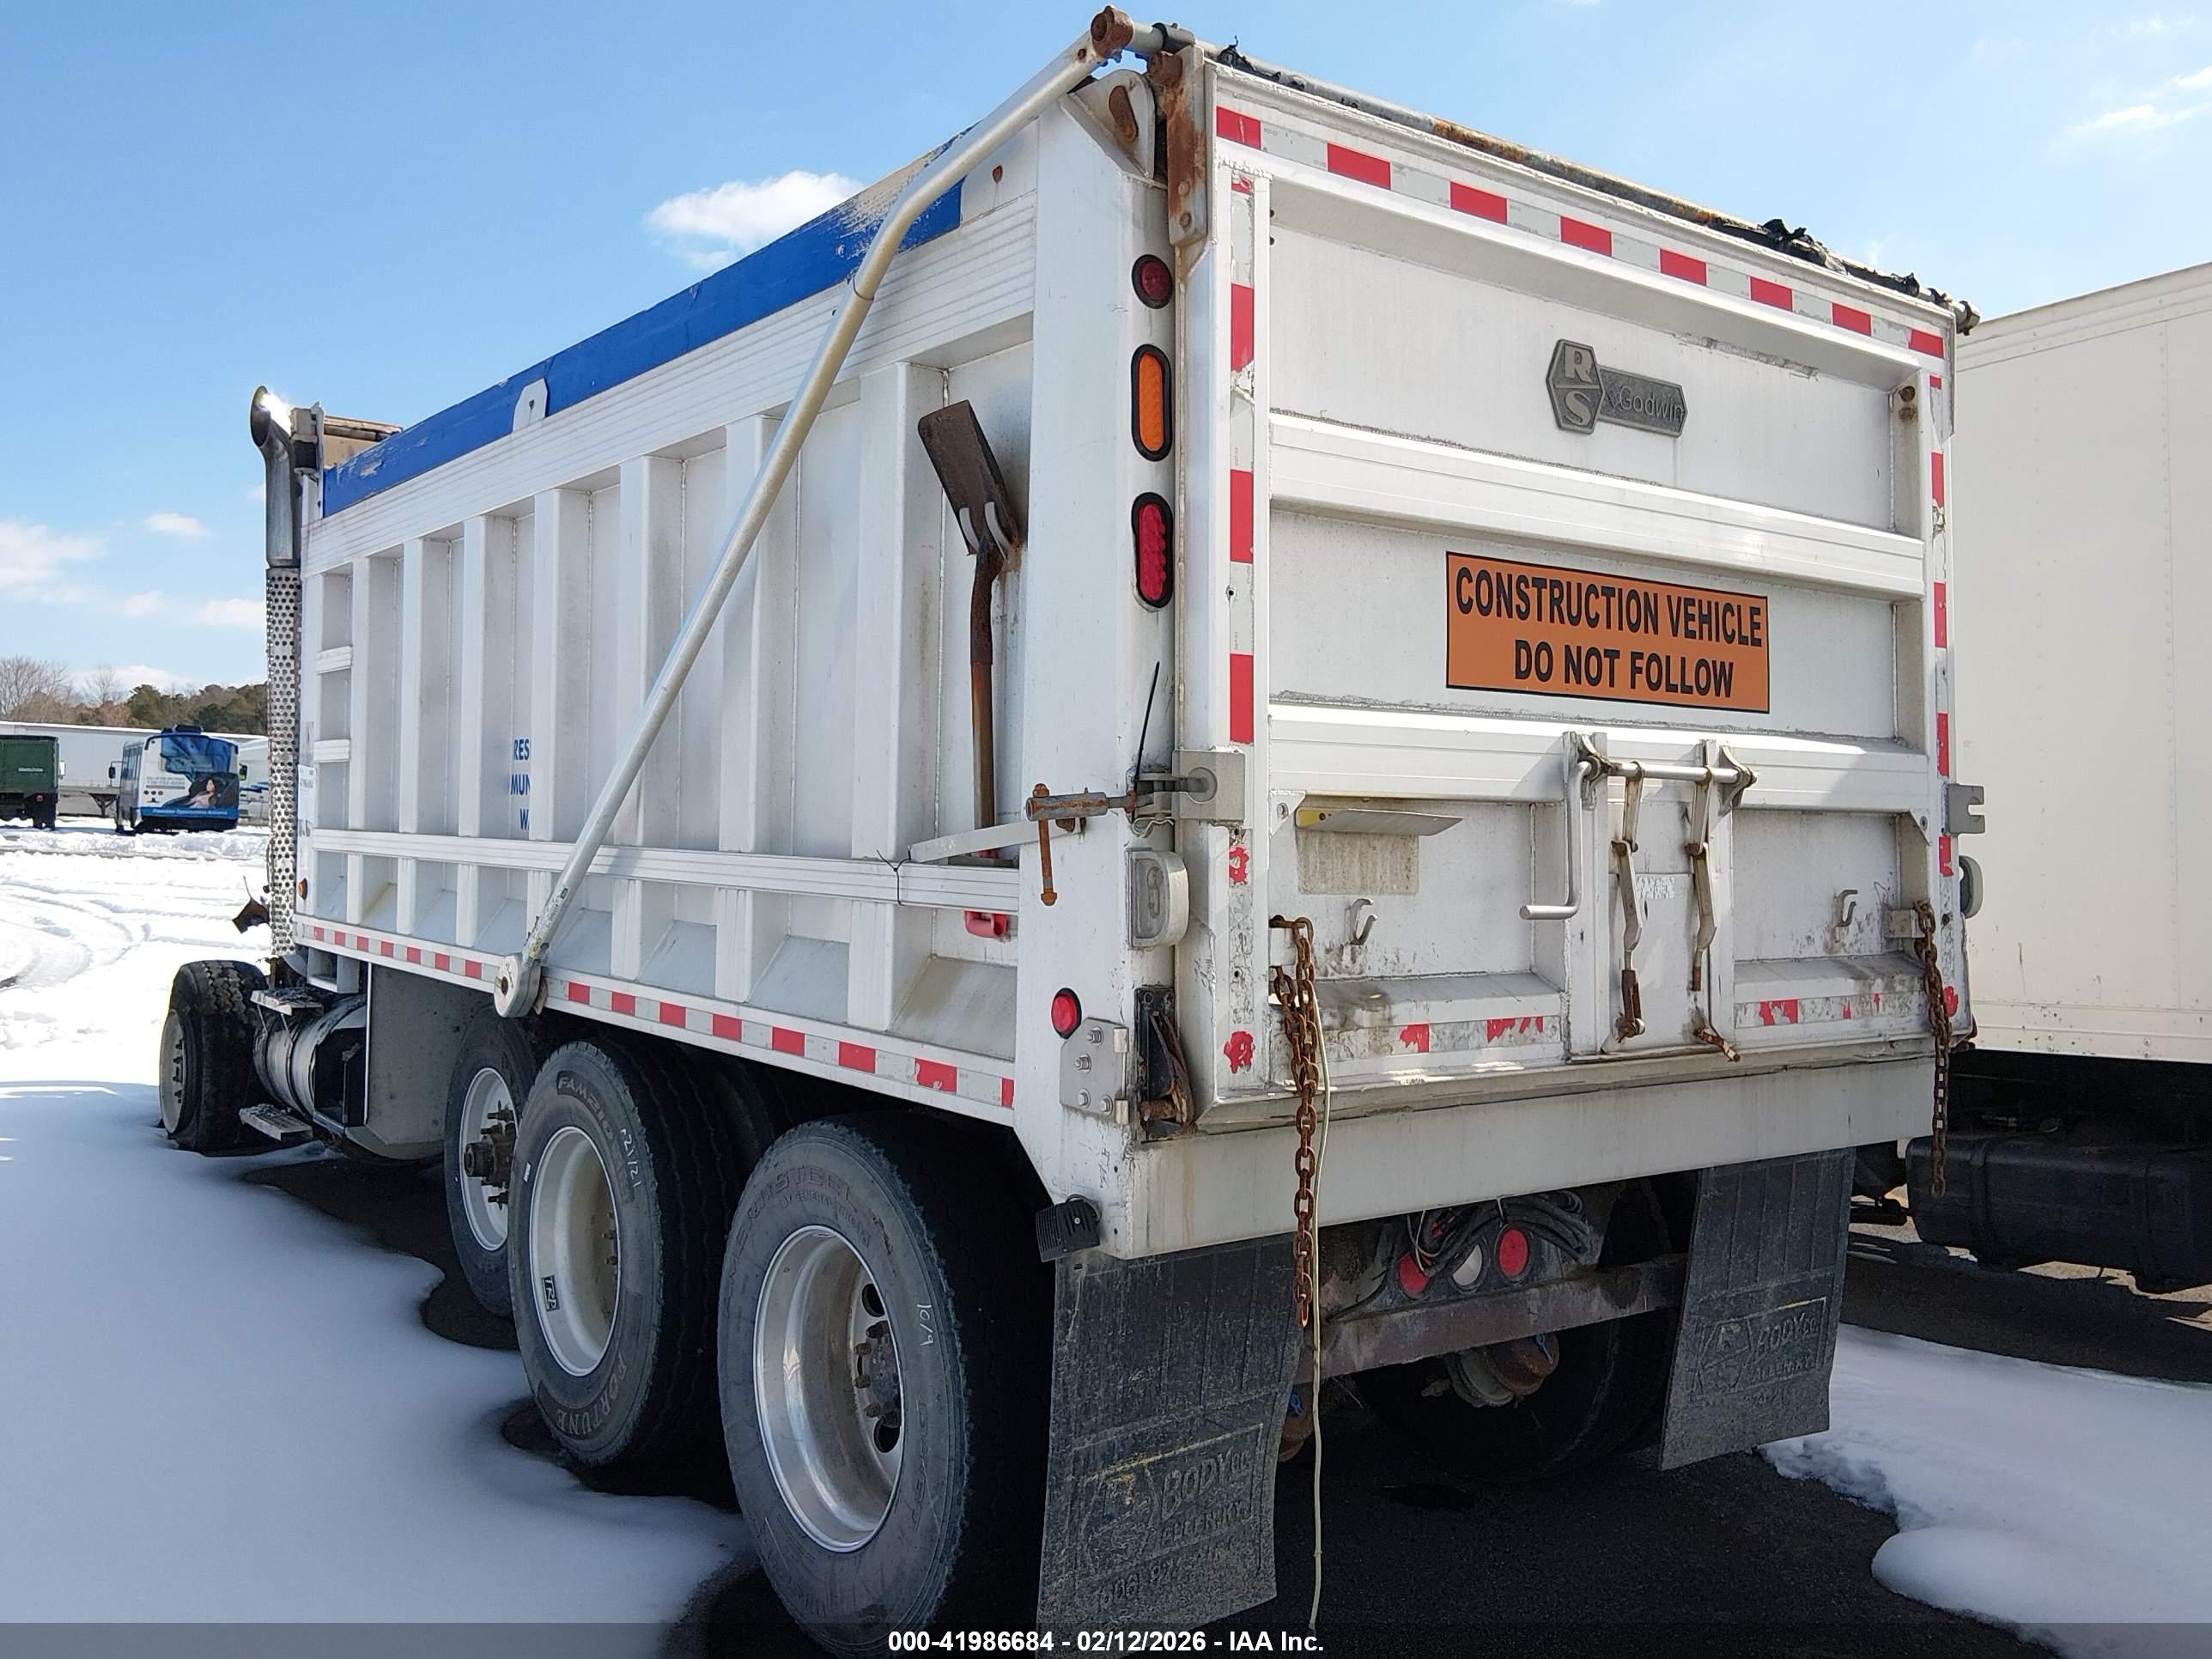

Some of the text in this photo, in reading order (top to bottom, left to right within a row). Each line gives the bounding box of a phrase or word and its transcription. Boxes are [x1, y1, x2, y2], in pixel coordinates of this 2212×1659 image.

[1564, 344, 1595, 384] R
[1564, 390, 1592, 427] S
[1619, 386, 1686, 423] Godwin
[1455, 566, 1763, 647] CONSTRUCTION VEHICLE
[1515, 639, 1734, 699] DO NOT FOLLOW
[507, 774, 531, 796] MUN
[520, 808, 530, 831] W
